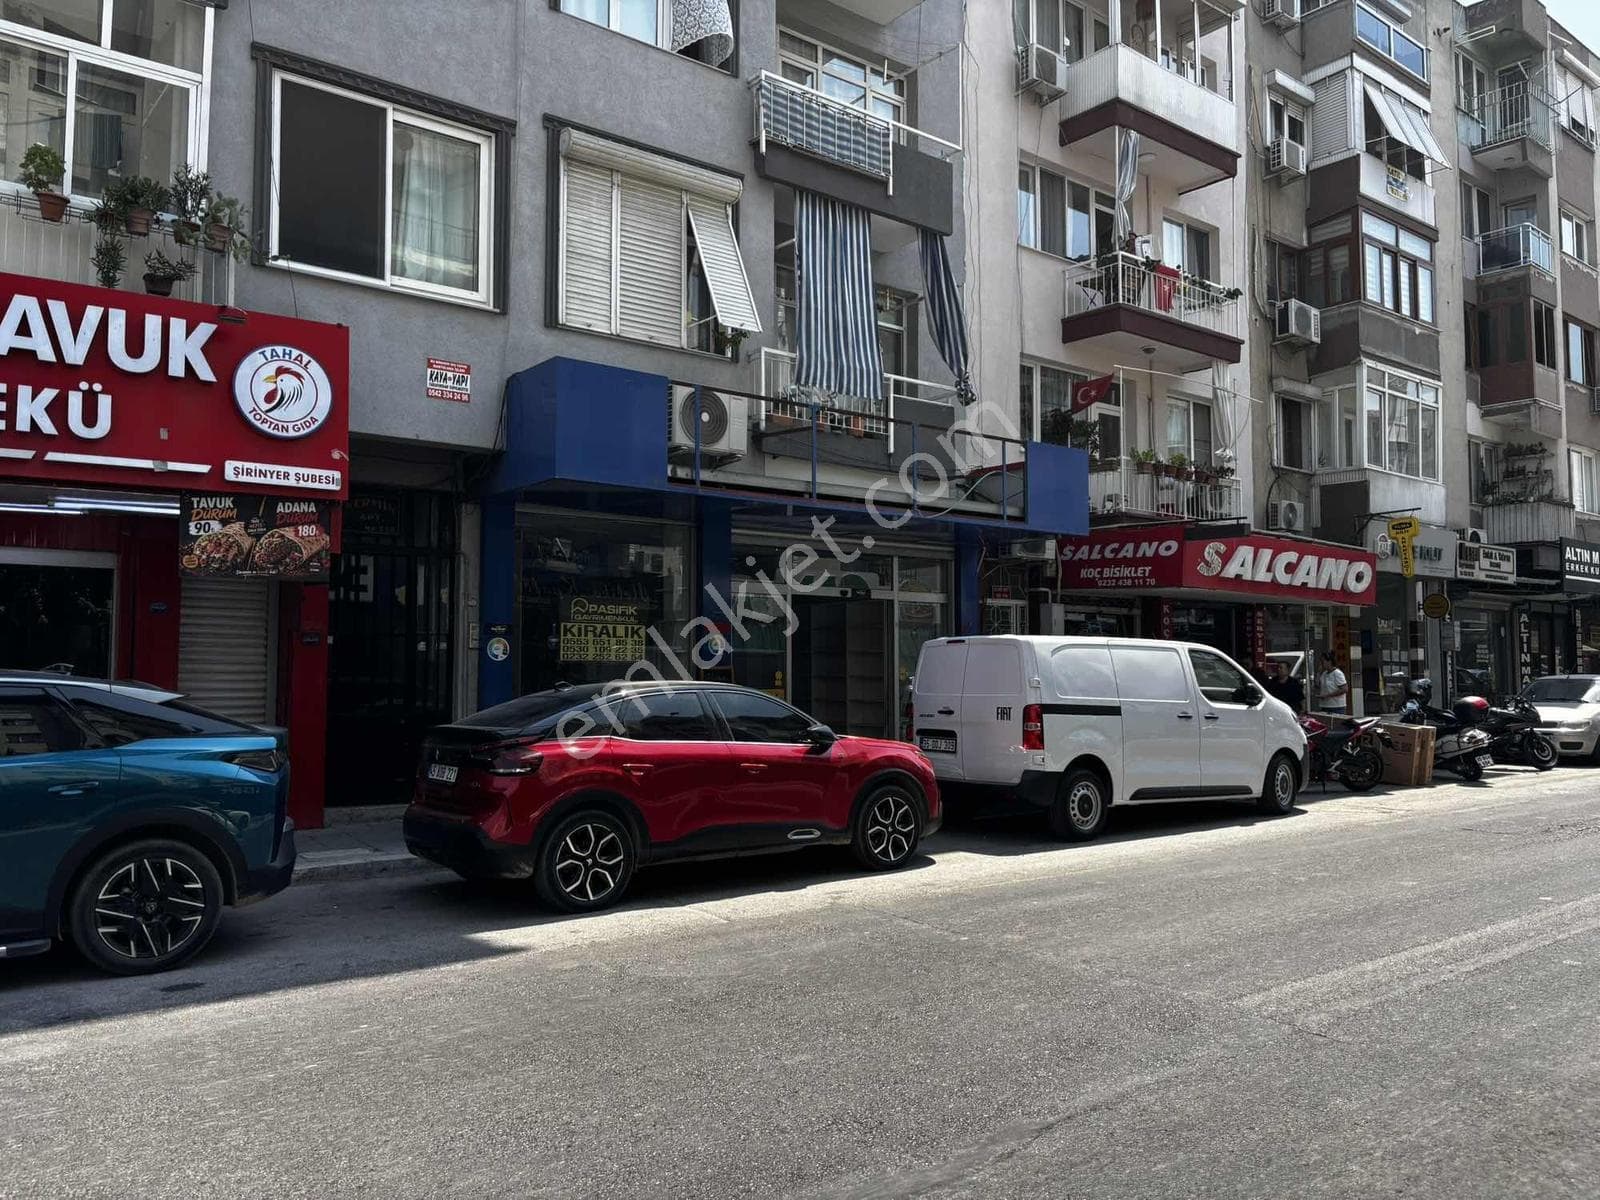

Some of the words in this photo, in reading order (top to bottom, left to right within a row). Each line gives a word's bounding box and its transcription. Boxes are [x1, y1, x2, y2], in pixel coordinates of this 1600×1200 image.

[258, 348, 312, 371] TAHAL
[429, 370, 447, 384] KAYA
[452, 374, 469, 387] YAPI
[0, 381, 112, 440] KÜ
[248, 407, 290, 434] TOPTAN
[292, 415, 319, 434] GIDA
[232, 465, 291, 482] ŞİRİNYER
[294, 468, 337, 486] ŞUBESİ
[191, 497, 234, 509] TAVUK
[276, 502, 316, 513] ADANA
[1061, 540, 1179, 560] SALCANO
[1565, 546, 1590, 563] ALTIN
[1080, 567, 1102, 580] KOÇ
[1103, 564, 1153, 577] BİSİKLET
[1196, 542, 1372, 594] SALCANO
[562, 623, 644, 639] KİRALIK
[996, 707, 1012, 721] FIAT
